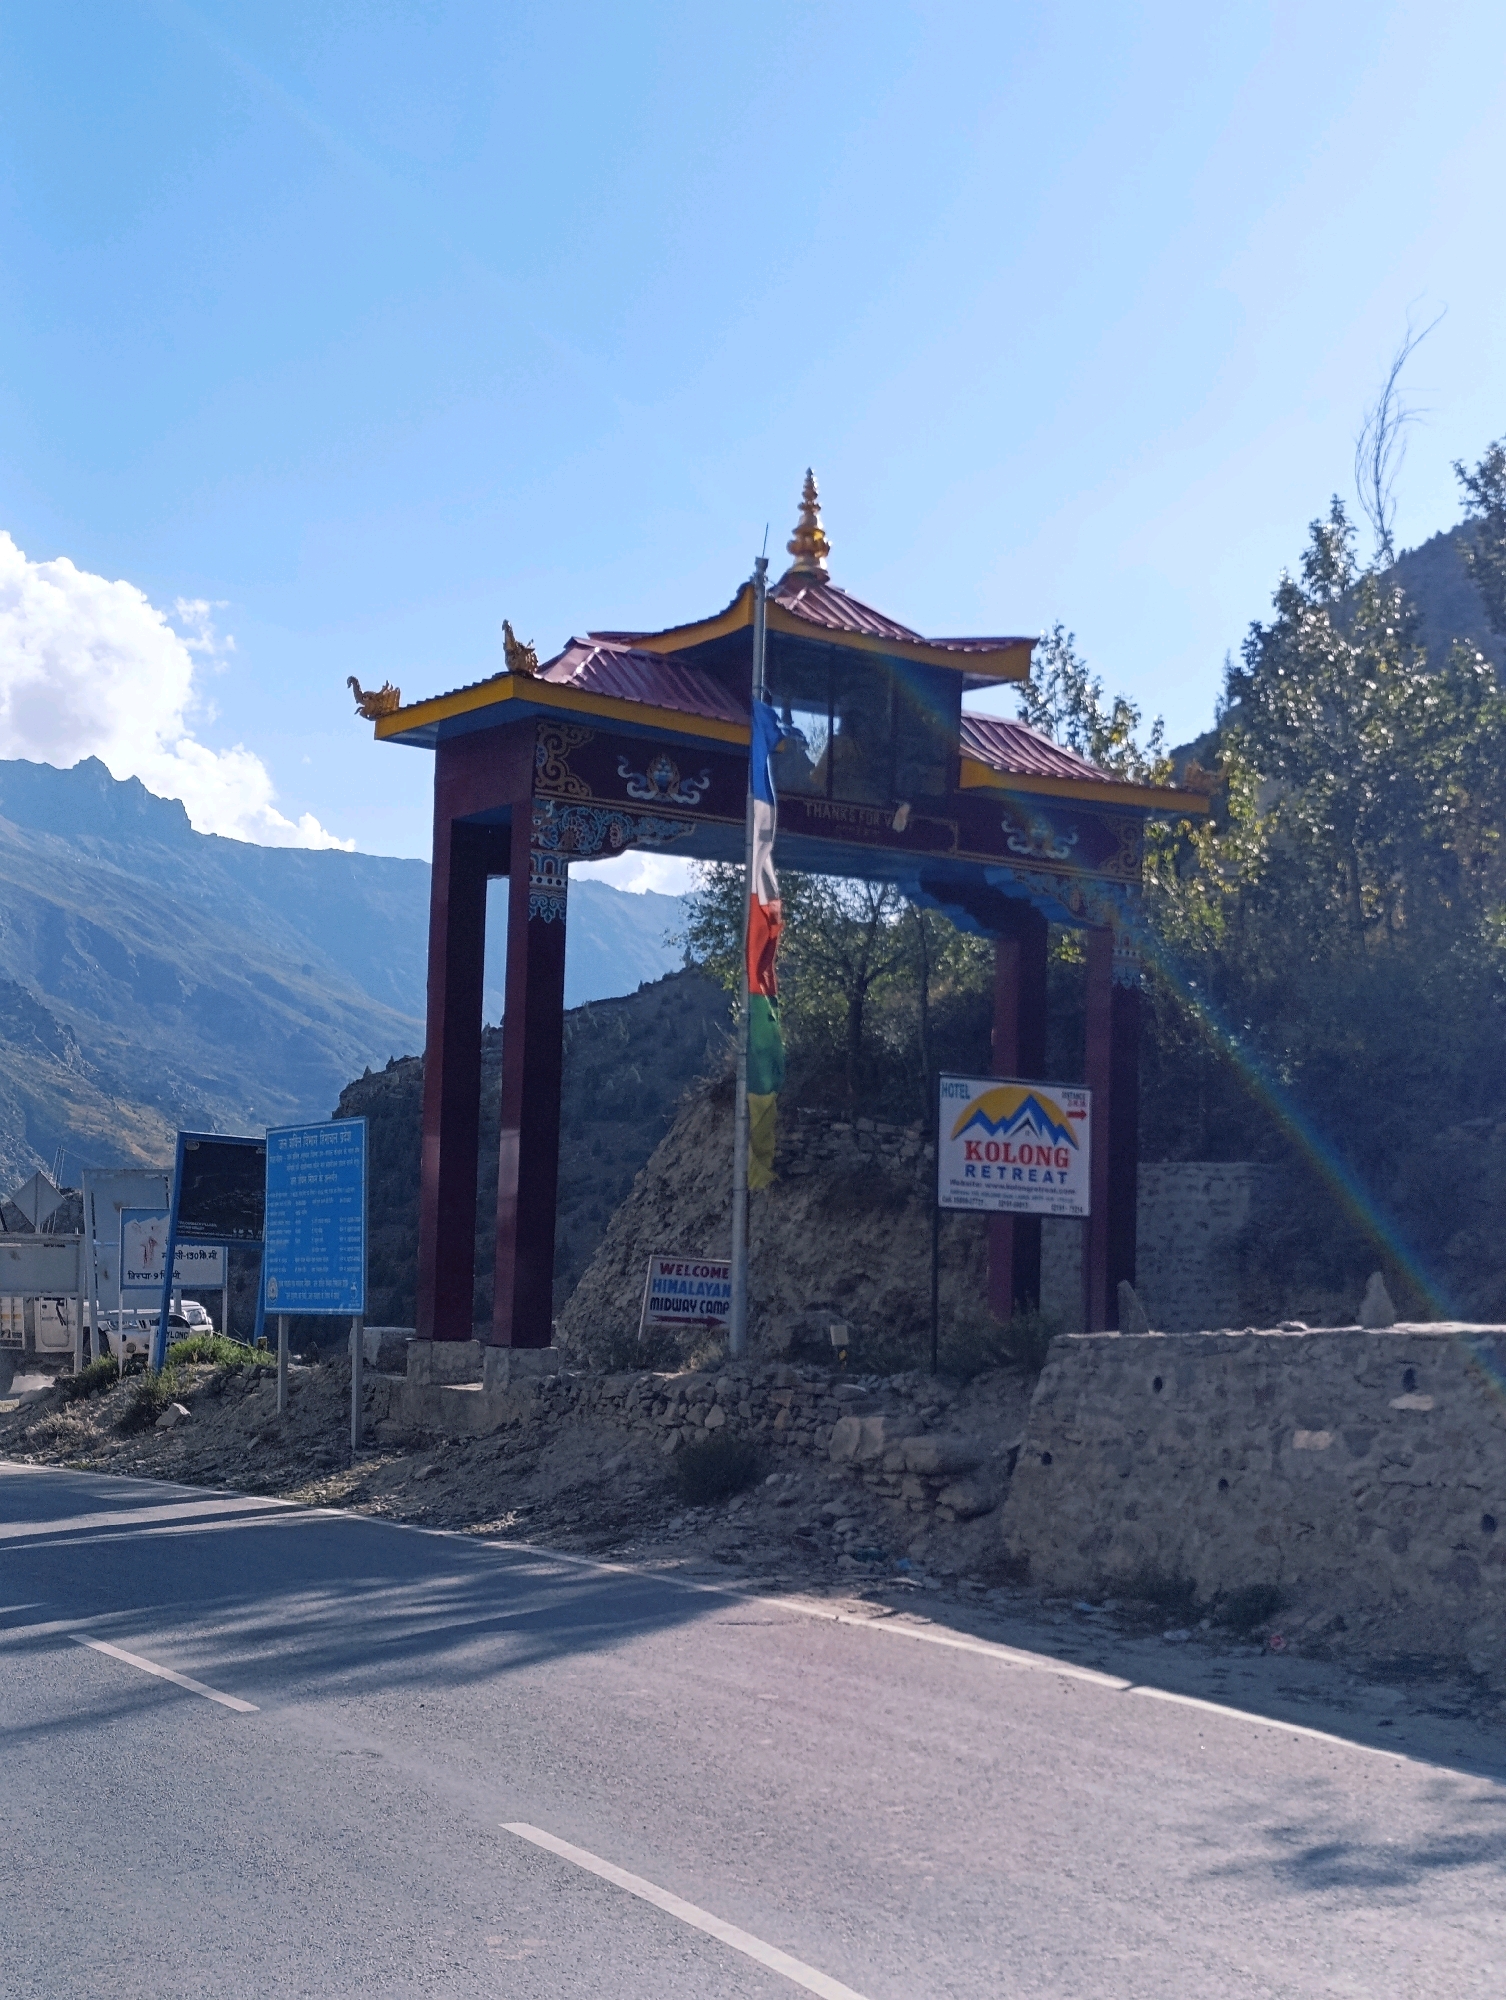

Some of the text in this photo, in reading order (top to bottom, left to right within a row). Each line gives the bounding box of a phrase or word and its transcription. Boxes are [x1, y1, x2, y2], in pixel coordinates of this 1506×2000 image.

[805, 803, 856, 823] THANKS
[858, 811, 880, 827] FOR
[941, 1081, 970, 1099] HOTEL
[964, 1140, 1069, 1168] KOLONG
[965, 1164, 1067, 1184] RETREAT
[950, 1179, 1075, 1195] Website: www.kolongretreat.com
[660, 1262, 729, 1279] WELCOME
[652, 1278, 731, 1297] HIMALAYAN
[650, 1297, 730, 1315] MIDWAY CAMP
